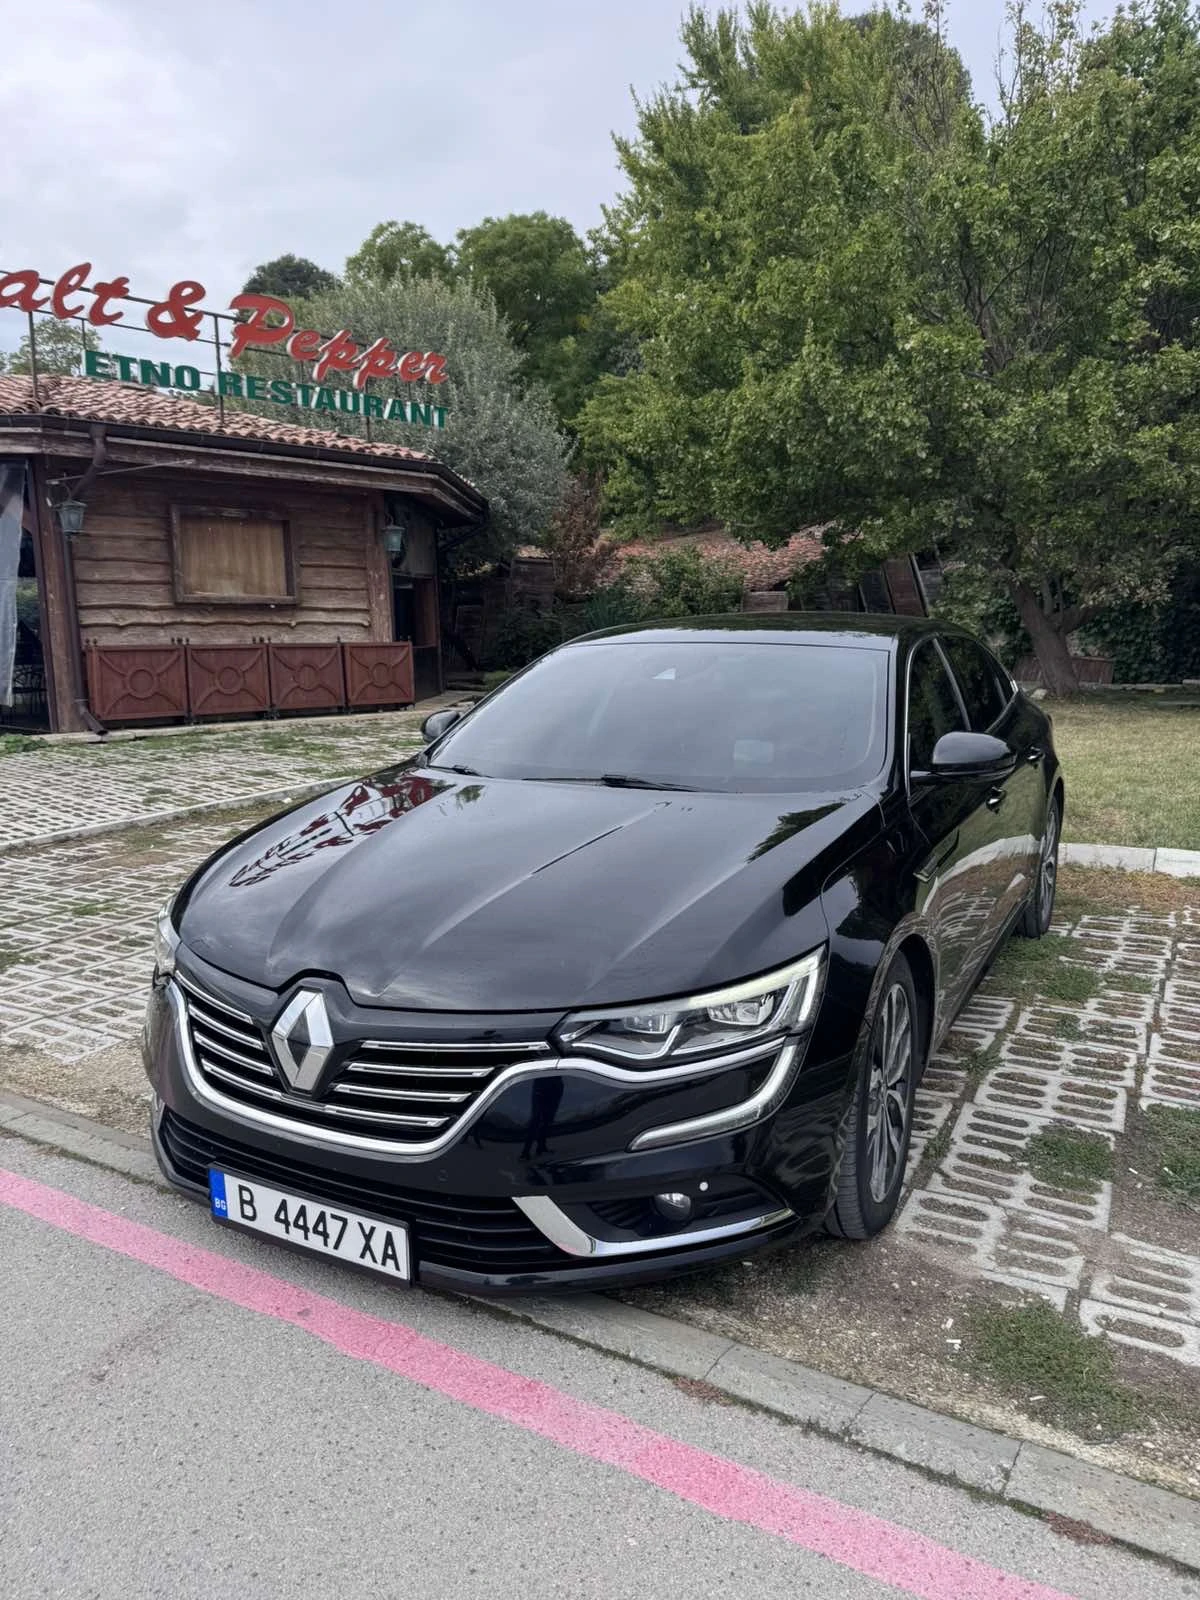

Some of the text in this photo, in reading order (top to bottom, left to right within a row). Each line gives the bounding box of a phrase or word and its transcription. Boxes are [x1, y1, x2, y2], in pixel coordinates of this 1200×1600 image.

[0, 262, 448, 389] alt & Pepper
[82, 349, 448, 429] ETNO RESTAURANT
[214, 1197, 227, 1211] BG
[238, 1184, 400, 1271] B 4447 XA
